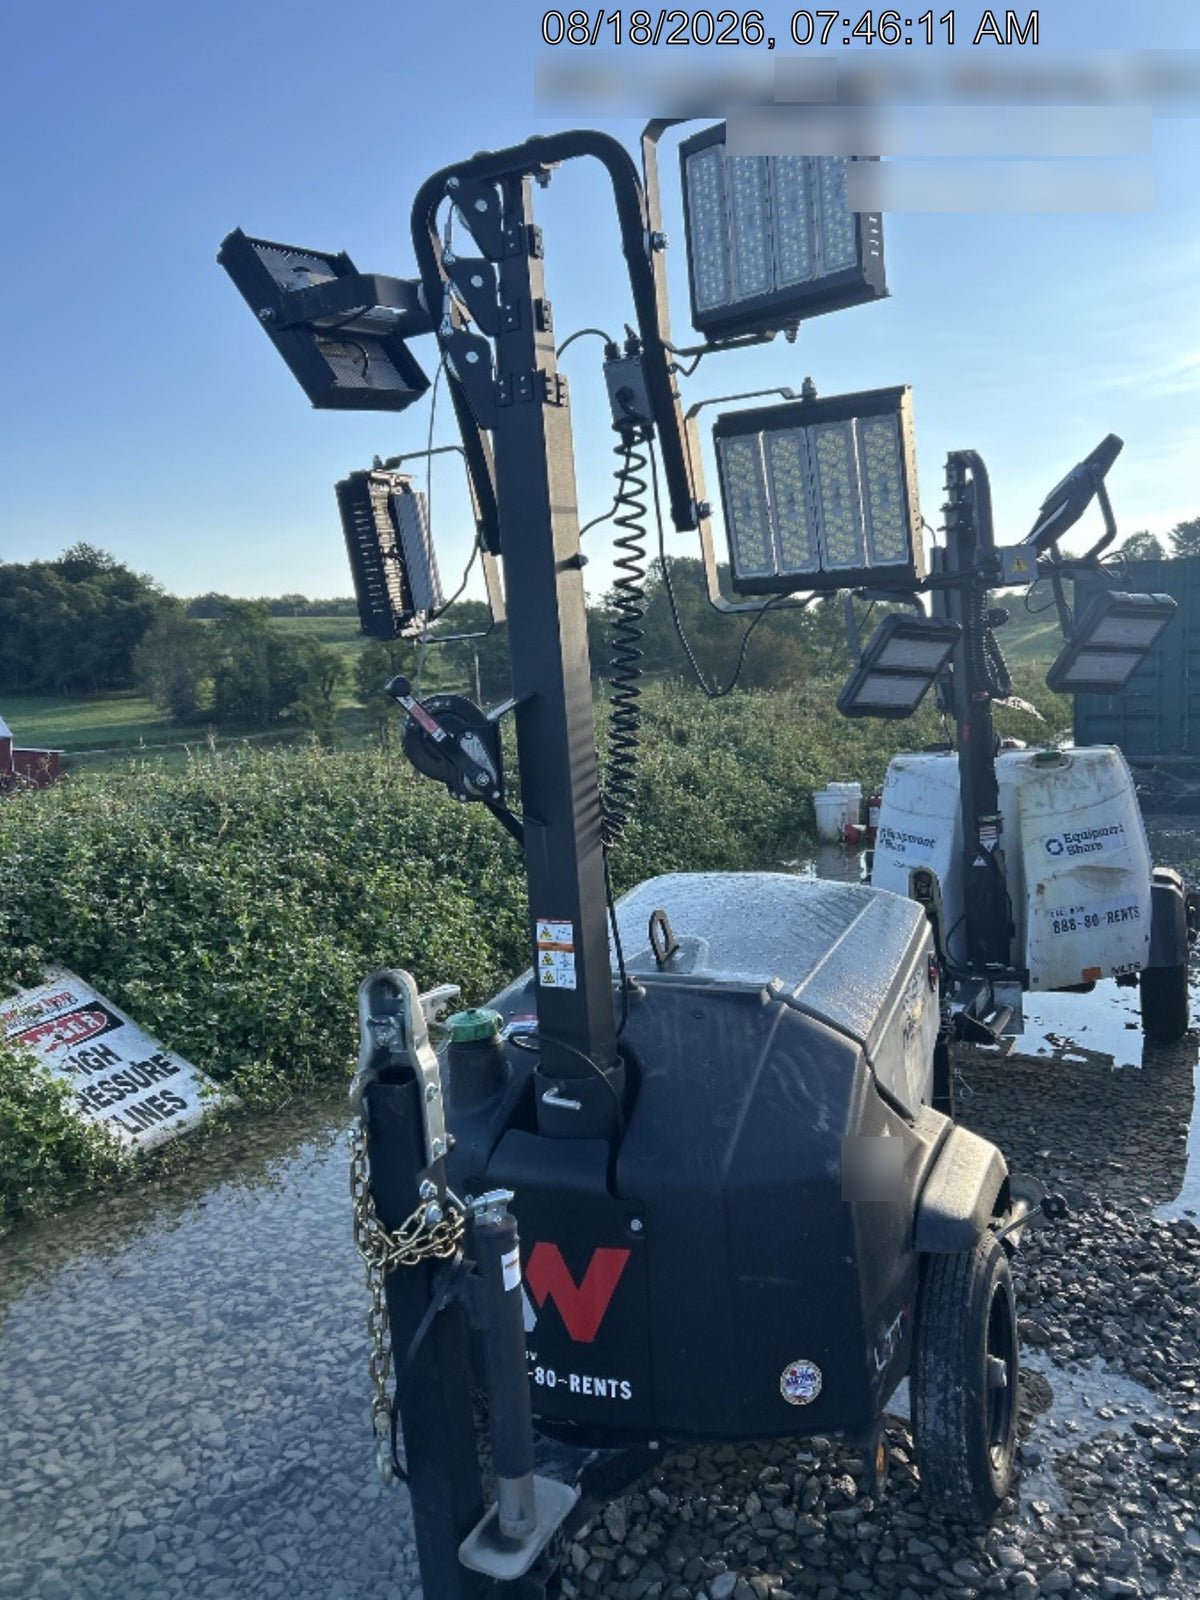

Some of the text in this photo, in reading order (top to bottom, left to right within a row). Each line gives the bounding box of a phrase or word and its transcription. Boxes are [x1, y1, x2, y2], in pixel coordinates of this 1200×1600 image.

[1053, 905, 1141, 934] 888-80-RENTS
[78, 1053, 181, 1115] RESSURE
[527, 1366, 633, 1400] -80-RENTS
